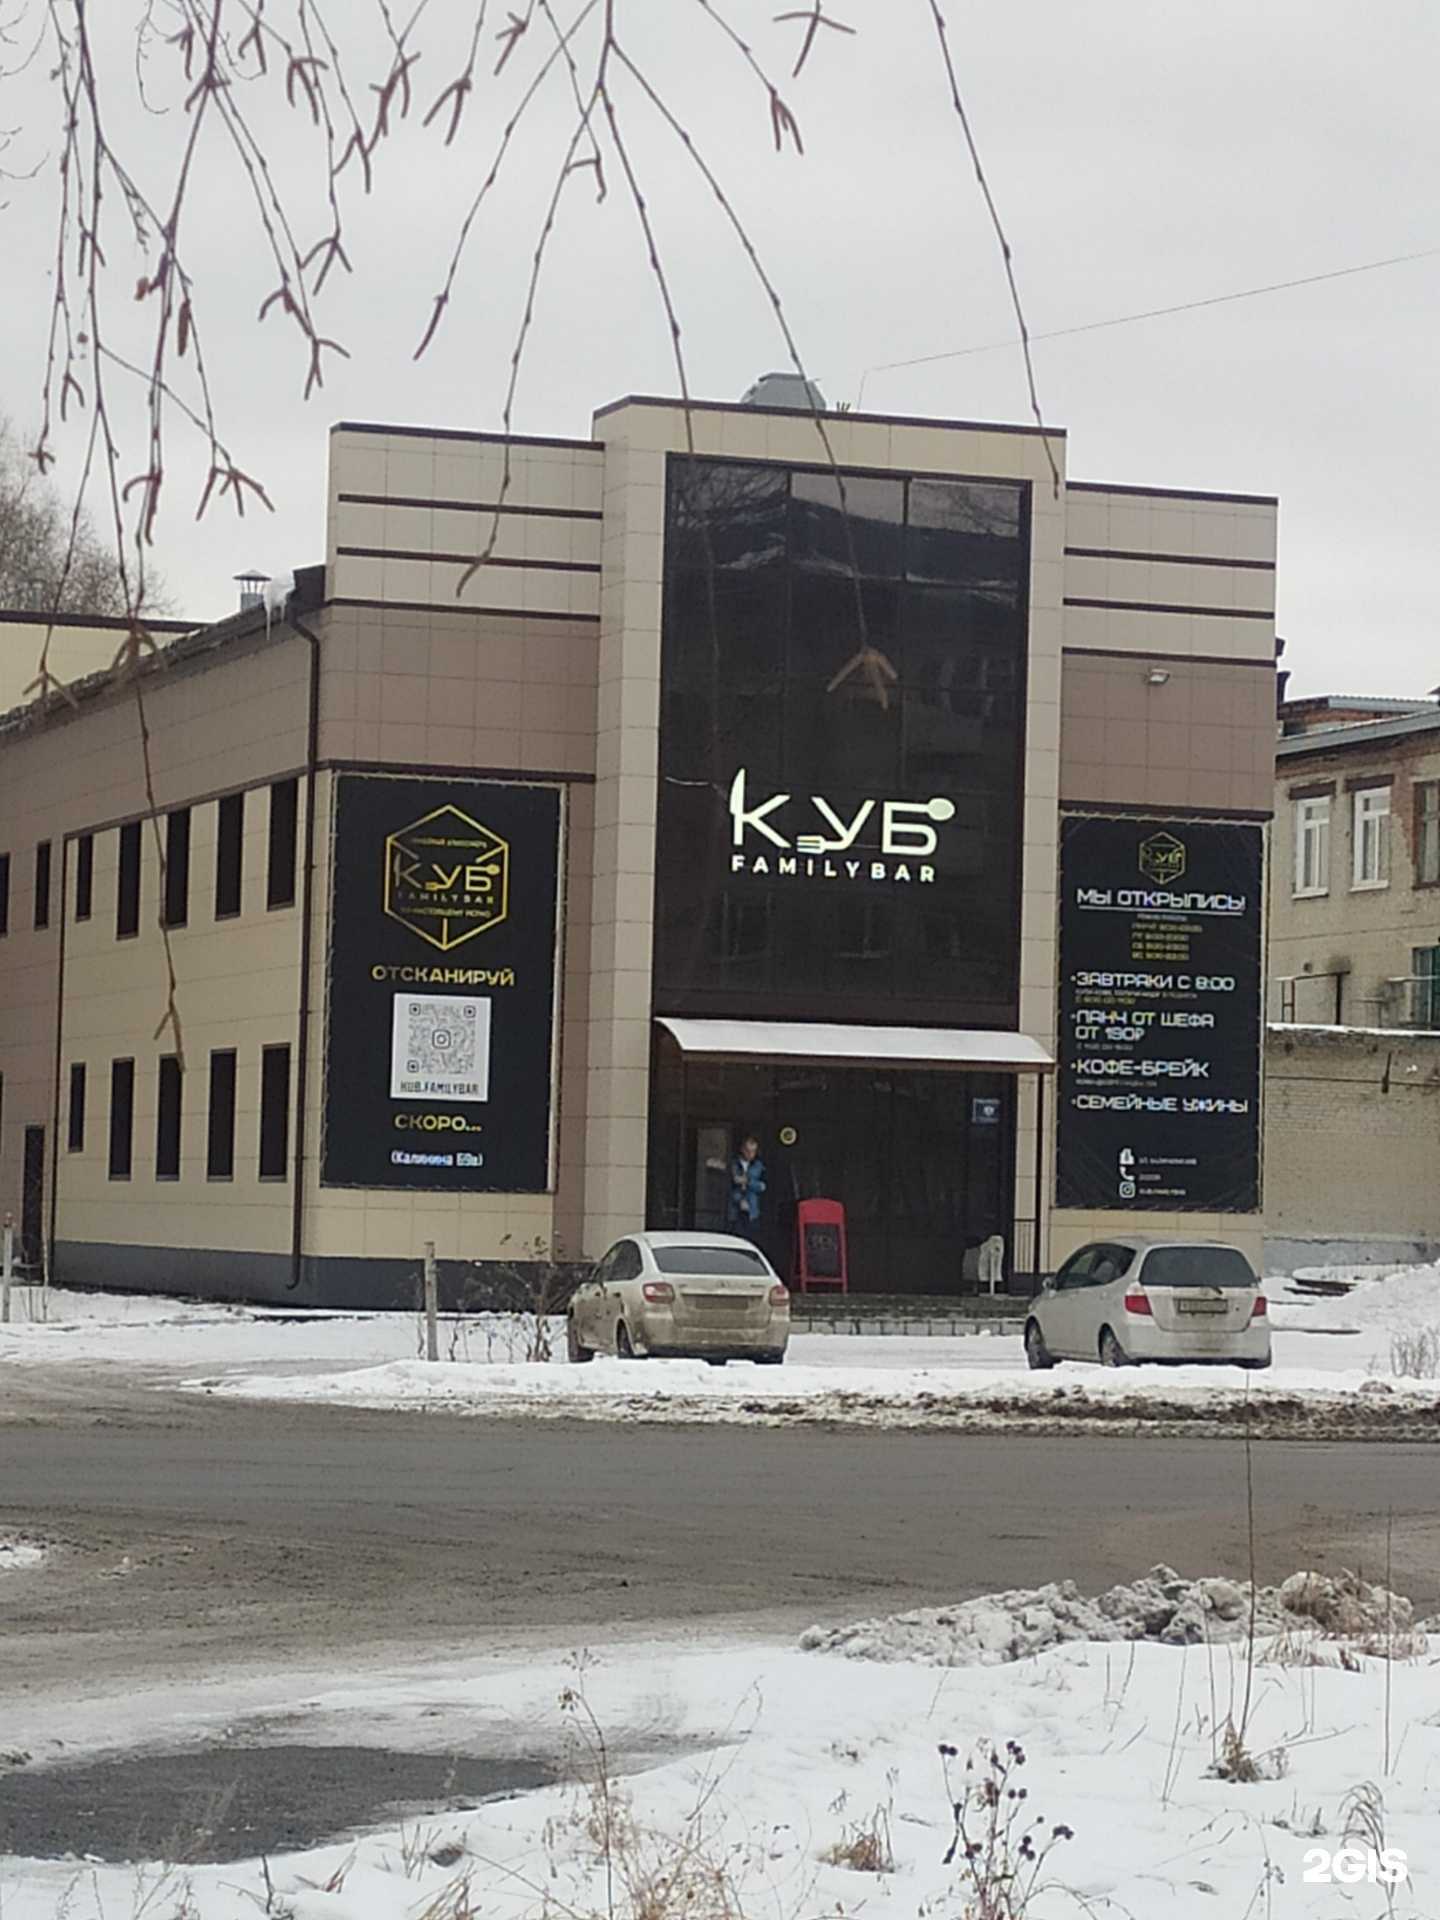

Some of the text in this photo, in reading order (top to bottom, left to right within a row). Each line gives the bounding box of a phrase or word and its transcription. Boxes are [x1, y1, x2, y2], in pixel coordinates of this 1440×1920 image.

[730, 768, 955, 855] КУБ
[393, 851, 500, 891] КУБ
[732, 855, 935, 882] FAMILYBAR
[1077, 888, 1112, 905] МЫ
[371, 964, 515, 987] ОТСКАНИРУЙ
[1131, 1011, 1156, 1026] ОТ
[1160, 1012, 1214, 1028] ШЕФА
[1075, 1025, 1100, 1040] ОТ
[1076, 1094, 1249, 1113] СЕМЕЙНЫЕ УЖИНЫ
